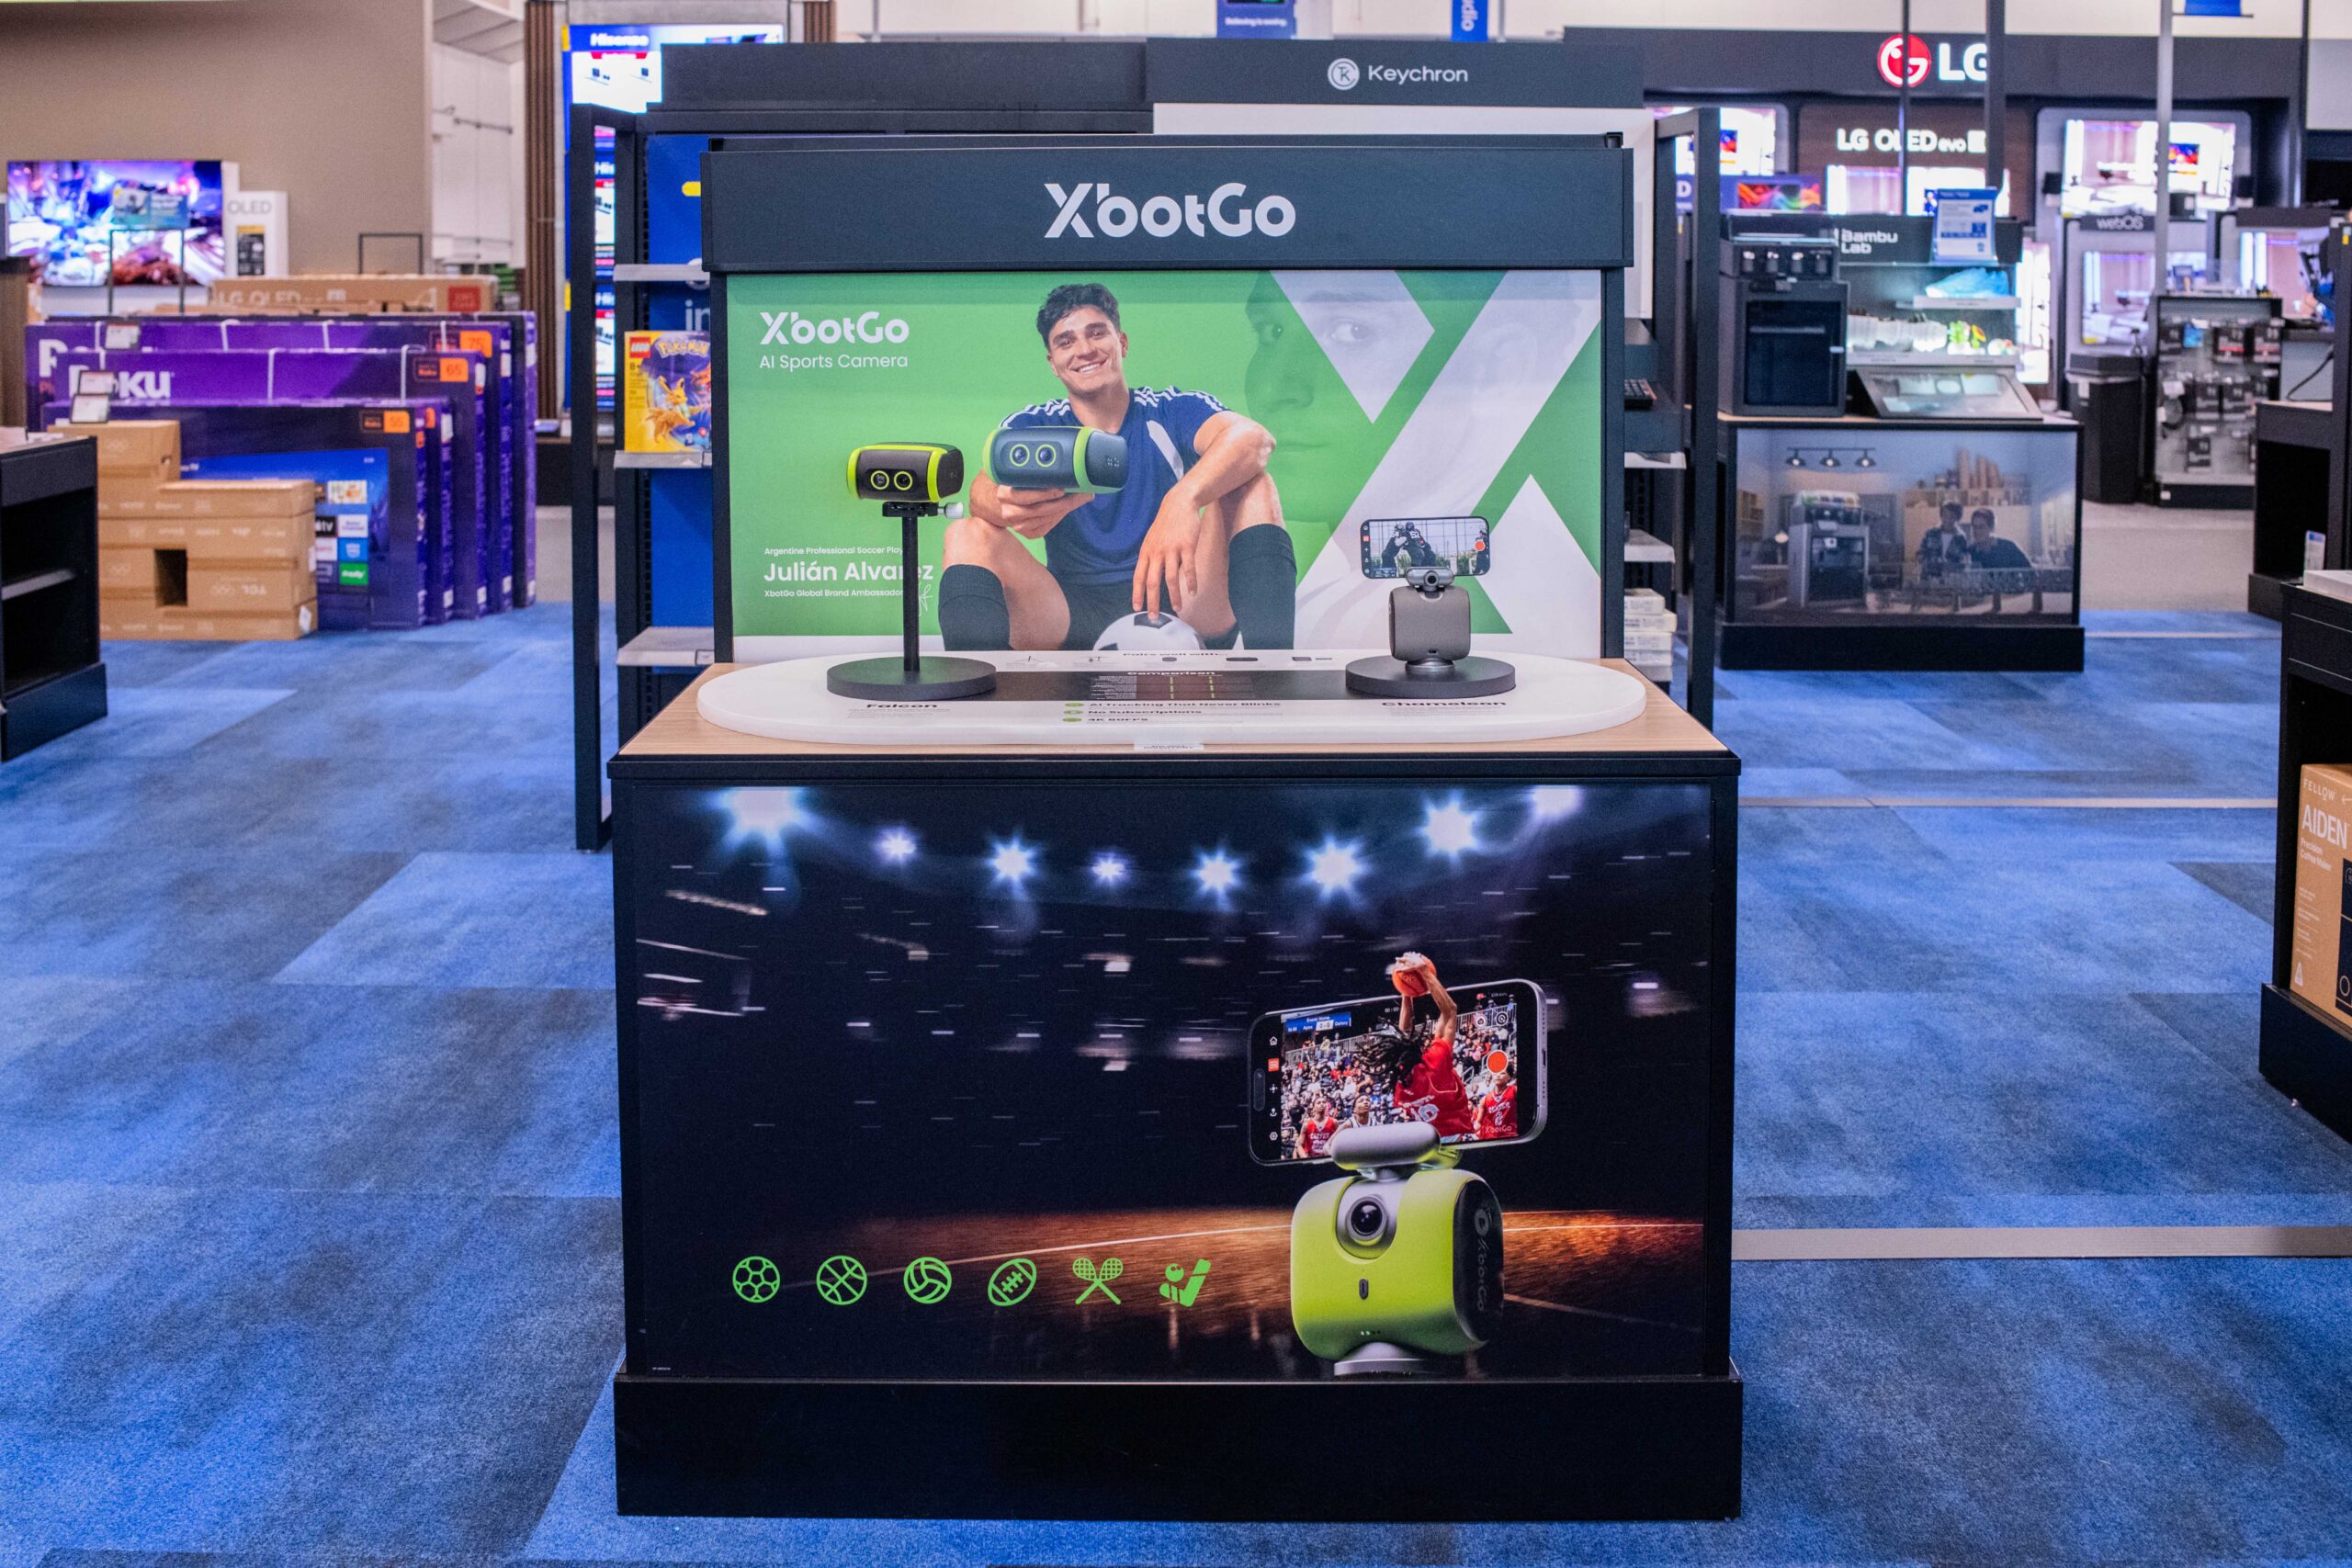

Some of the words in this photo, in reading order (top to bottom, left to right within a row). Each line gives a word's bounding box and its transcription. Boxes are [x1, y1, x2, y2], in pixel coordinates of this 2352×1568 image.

[1368, 65, 1468, 85] Keychron
[1838, 128, 1869, 151] LG
[229, 199, 272, 215] OLED
[1044, 182, 1296, 238] XbotGo
[2097, 214, 2143, 231] webOS
[1841, 229, 1898, 243] Bambu
[1841, 243, 1871, 254] Lab
[760, 310, 910, 345] XbotGo
[631, 342, 650, 353] LEGO
[760, 355, 775, 368] AI
[779, 355, 833, 372] Sports
[837, 354, 909, 367] Camera
[764, 547, 804, 556] Argentine
[806, 547, 855, 555] Professional
[887, 546, 903, 556] Play
[764, 560, 837, 581] Julián
[844, 561, 933, 581] Alvarz
[764, 590, 795, 598] XbotGo
[797, 589, 823, 597] Global
[851, 588, 903, 596] Ambassador
[2303, 778, 2335, 801] FELLOW
[2302, 805, 2347, 850] AIDEN
